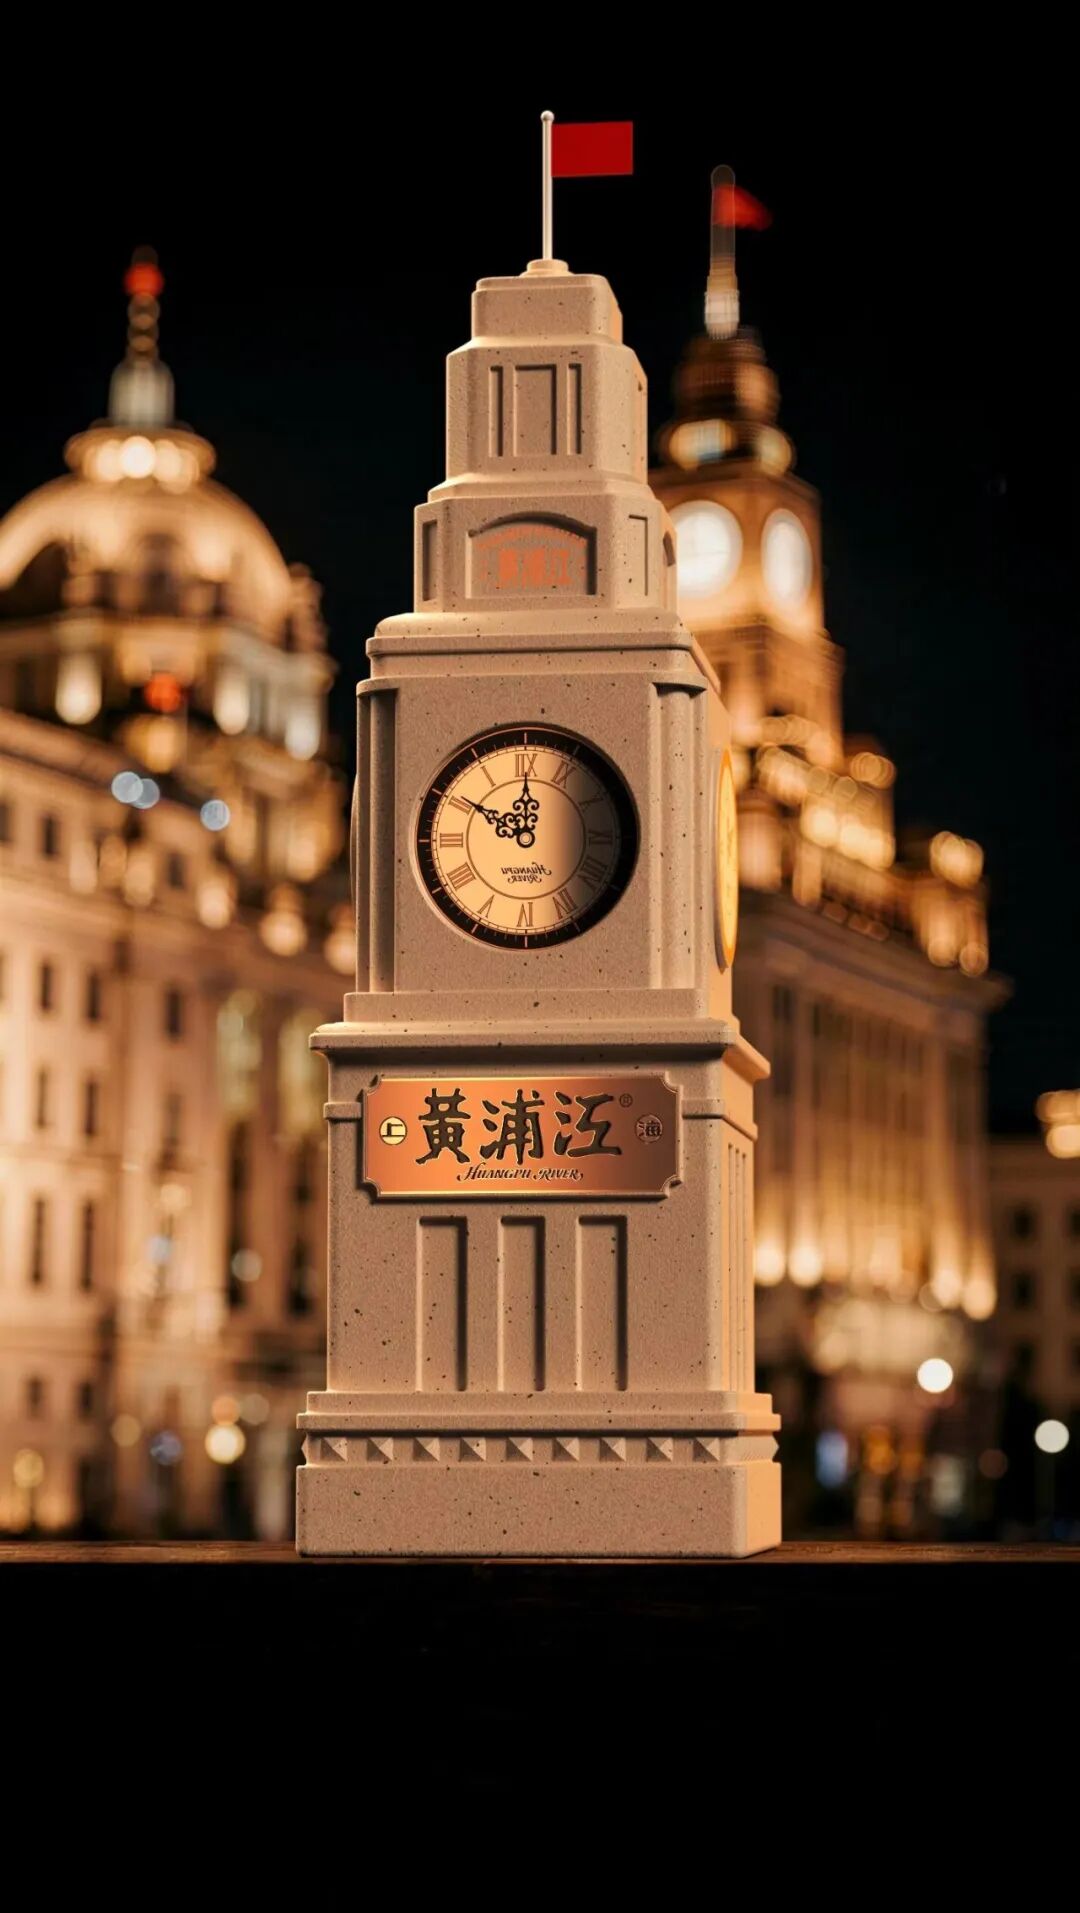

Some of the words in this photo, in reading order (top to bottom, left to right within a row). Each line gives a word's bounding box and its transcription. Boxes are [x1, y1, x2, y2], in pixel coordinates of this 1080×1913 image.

[416, 1088, 623, 1165] 黄浦江
[533, 1167, 584, 1182] RIVER
